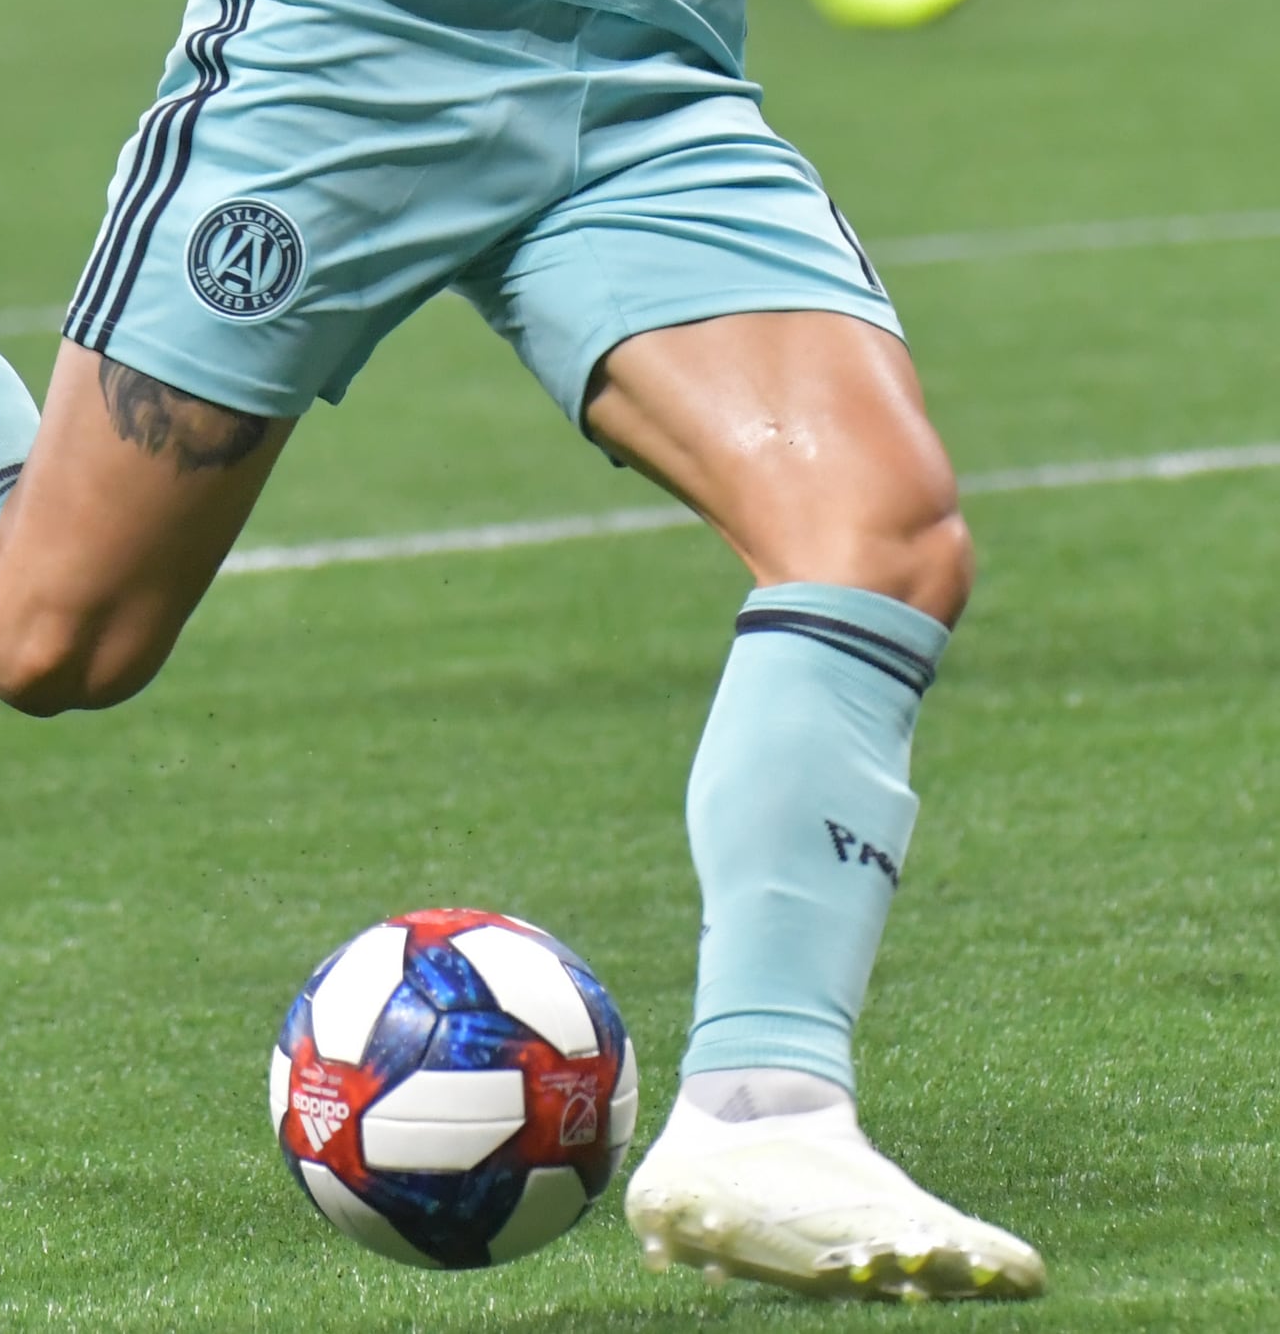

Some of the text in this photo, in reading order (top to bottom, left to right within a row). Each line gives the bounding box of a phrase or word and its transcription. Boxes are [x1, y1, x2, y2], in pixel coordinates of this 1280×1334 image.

[221, 208, 293, 250] ATLANTA
[195, 265, 275, 310] UNITED FC
[292, 1092, 350, 1121] adidas
